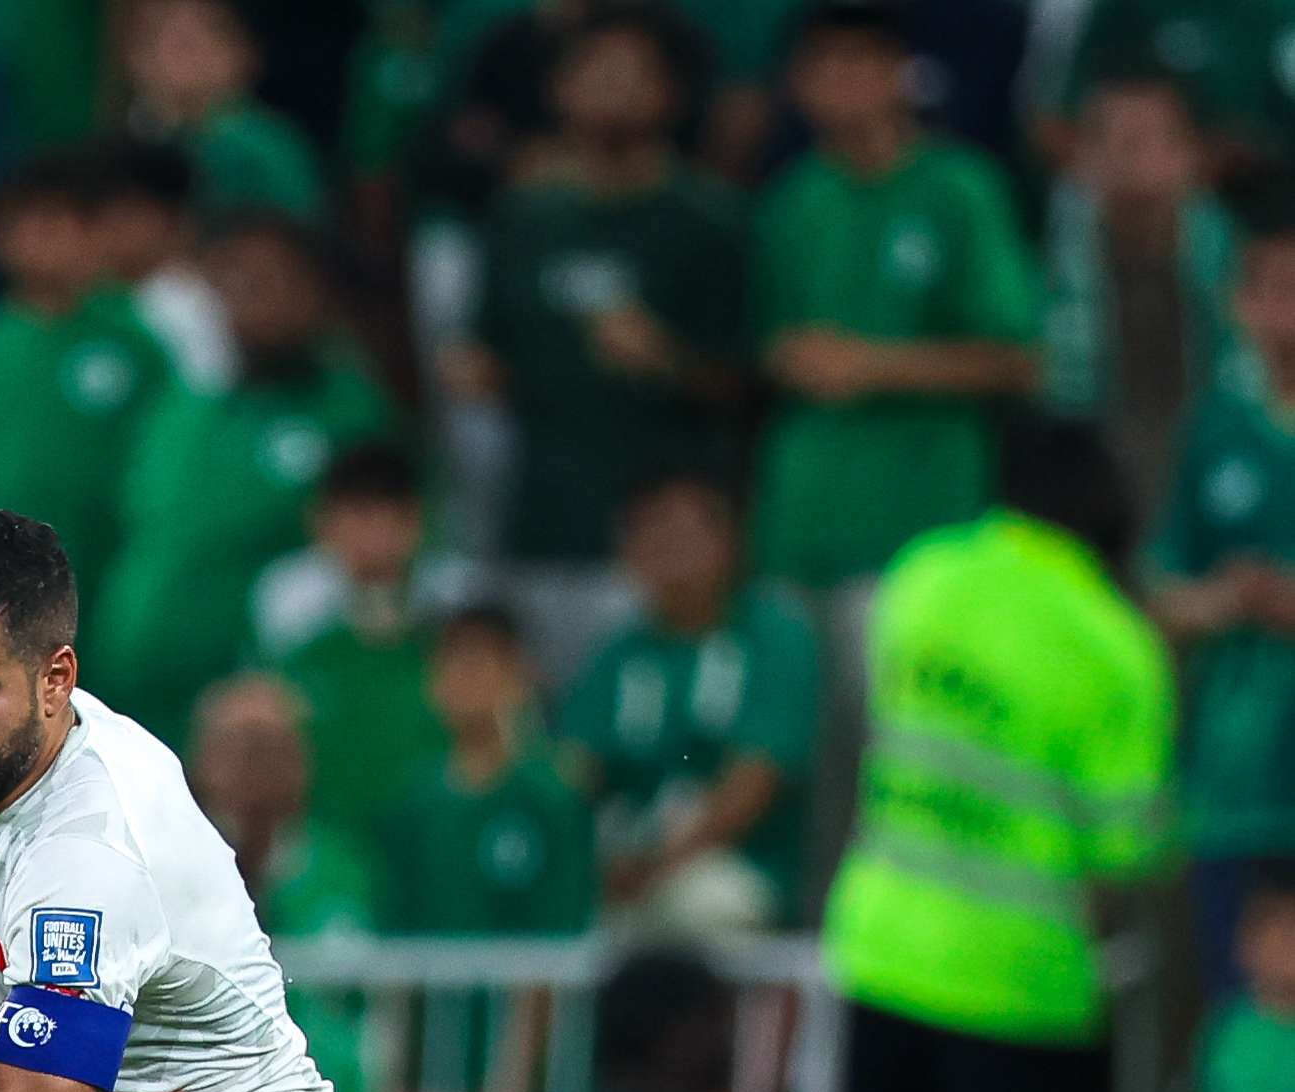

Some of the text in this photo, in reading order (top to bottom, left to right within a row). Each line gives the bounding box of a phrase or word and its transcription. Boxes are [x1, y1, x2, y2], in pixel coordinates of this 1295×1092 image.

[44, 921, 86, 935] FOOTBALL
[44, 933, 86, 951] UNITES
[42, 948, 87, 965] the World
